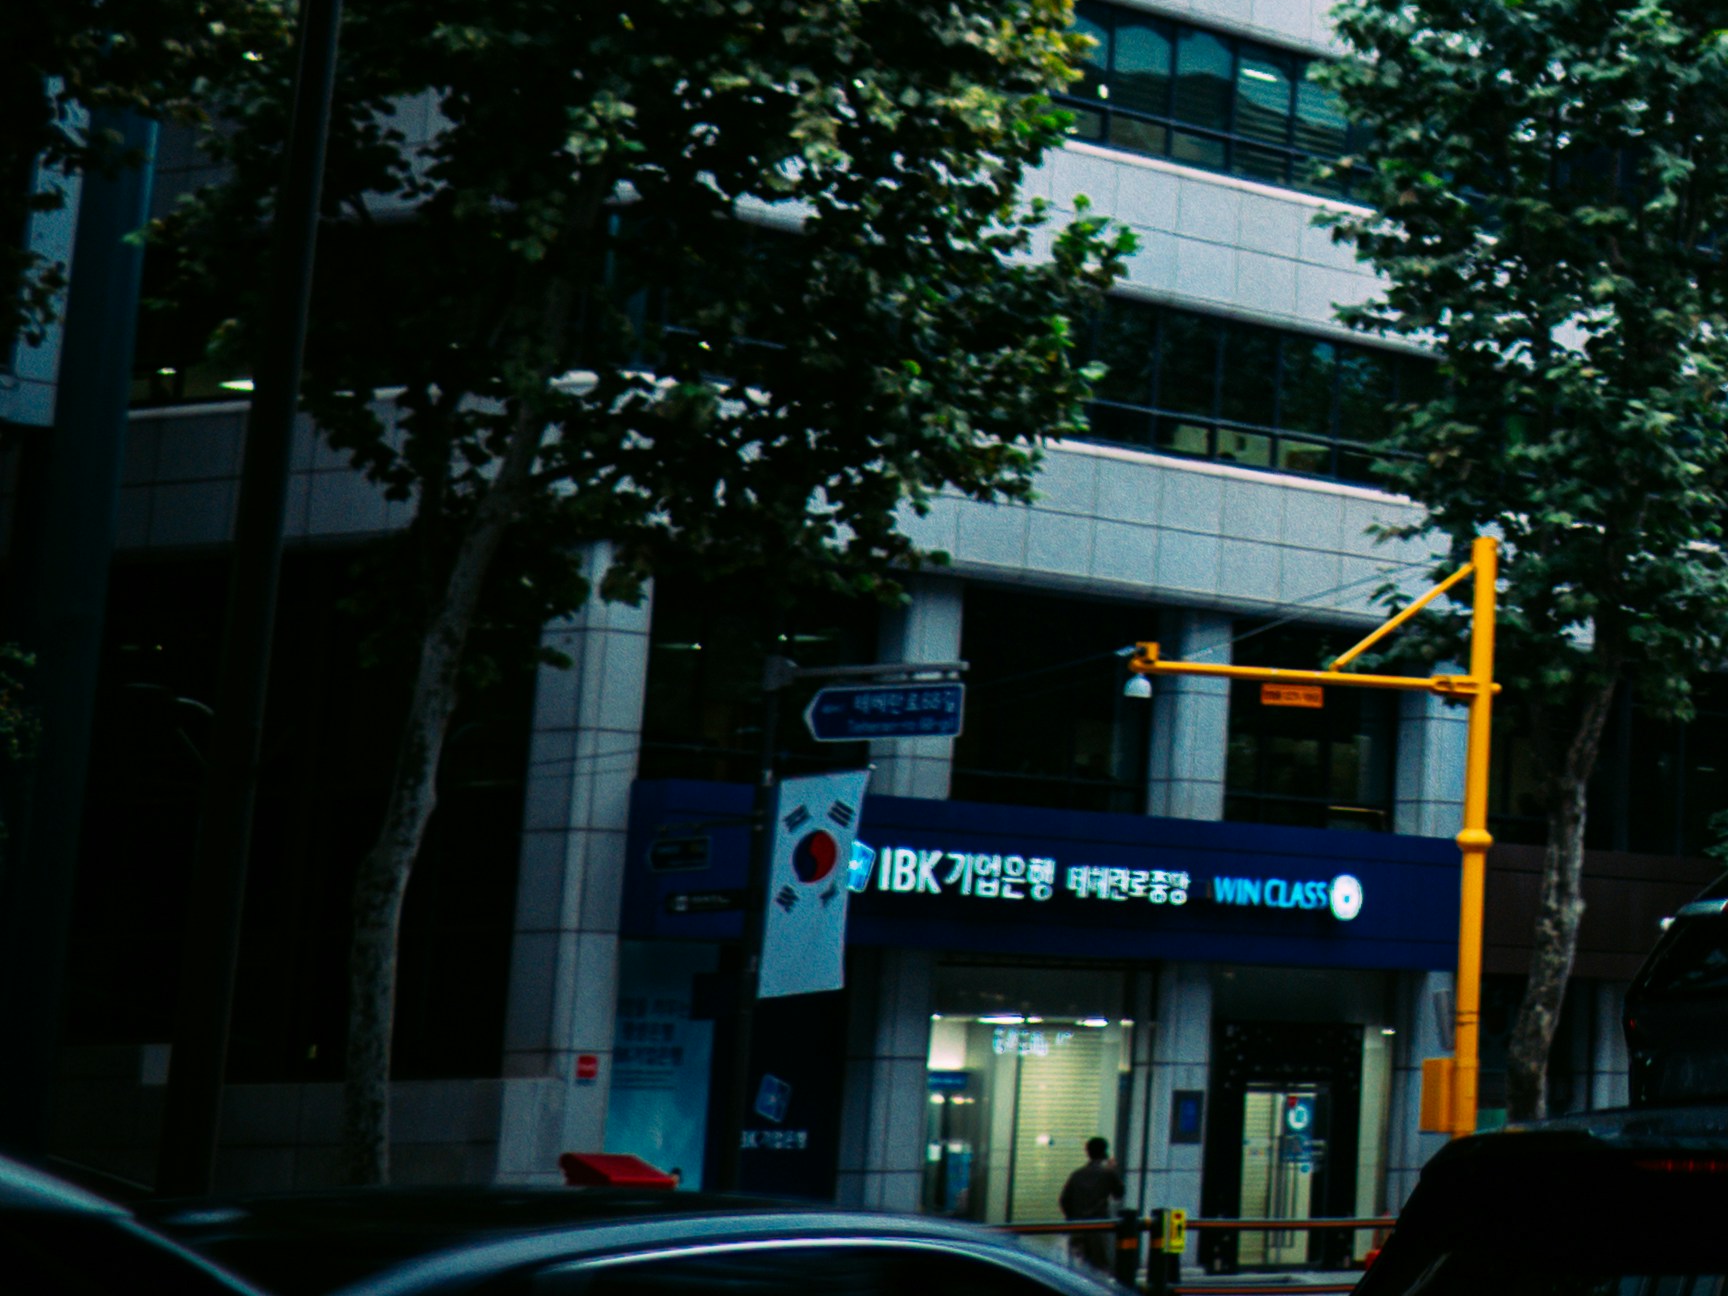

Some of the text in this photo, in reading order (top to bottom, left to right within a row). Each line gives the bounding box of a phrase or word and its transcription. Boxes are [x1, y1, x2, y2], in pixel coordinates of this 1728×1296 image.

[878, 846, 1056, 901] IBK기업은행
[1213, 875, 1261, 906] WIN
[1264, 877, 1329, 910] CLASS
